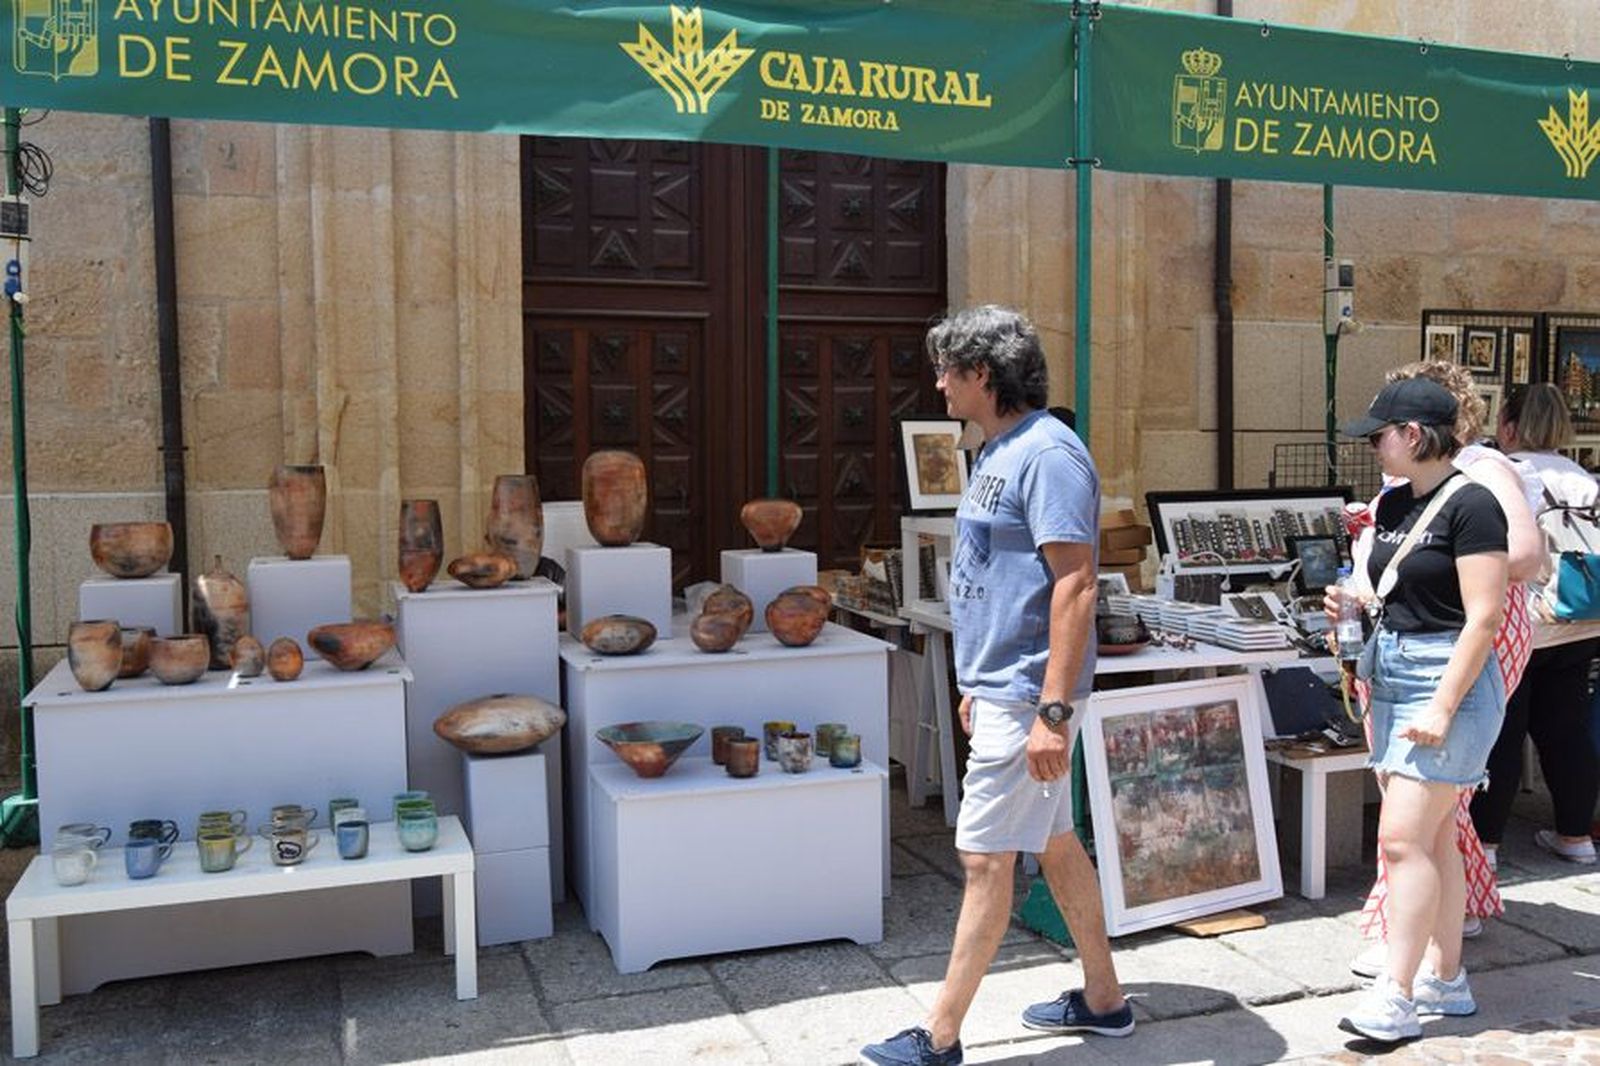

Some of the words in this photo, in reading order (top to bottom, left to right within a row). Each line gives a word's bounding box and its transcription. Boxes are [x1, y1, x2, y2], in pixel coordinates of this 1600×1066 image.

[114, 0, 457, 47] AYUNTAMIENTO
[118, 34, 191, 81] DE
[216, 40, 459, 99] ZAMORA
[759, 50, 856, 96] CAJA
[859, 61, 992, 108] RURAL
[760, 98, 790, 121] DE
[800, 103, 900, 131] ZAMORA
[1235, 81, 1440, 123] AYUNTAMIENTO
[1233, 117, 1279, 154] DE
[1291, 122, 1437, 165] ZAMORA
